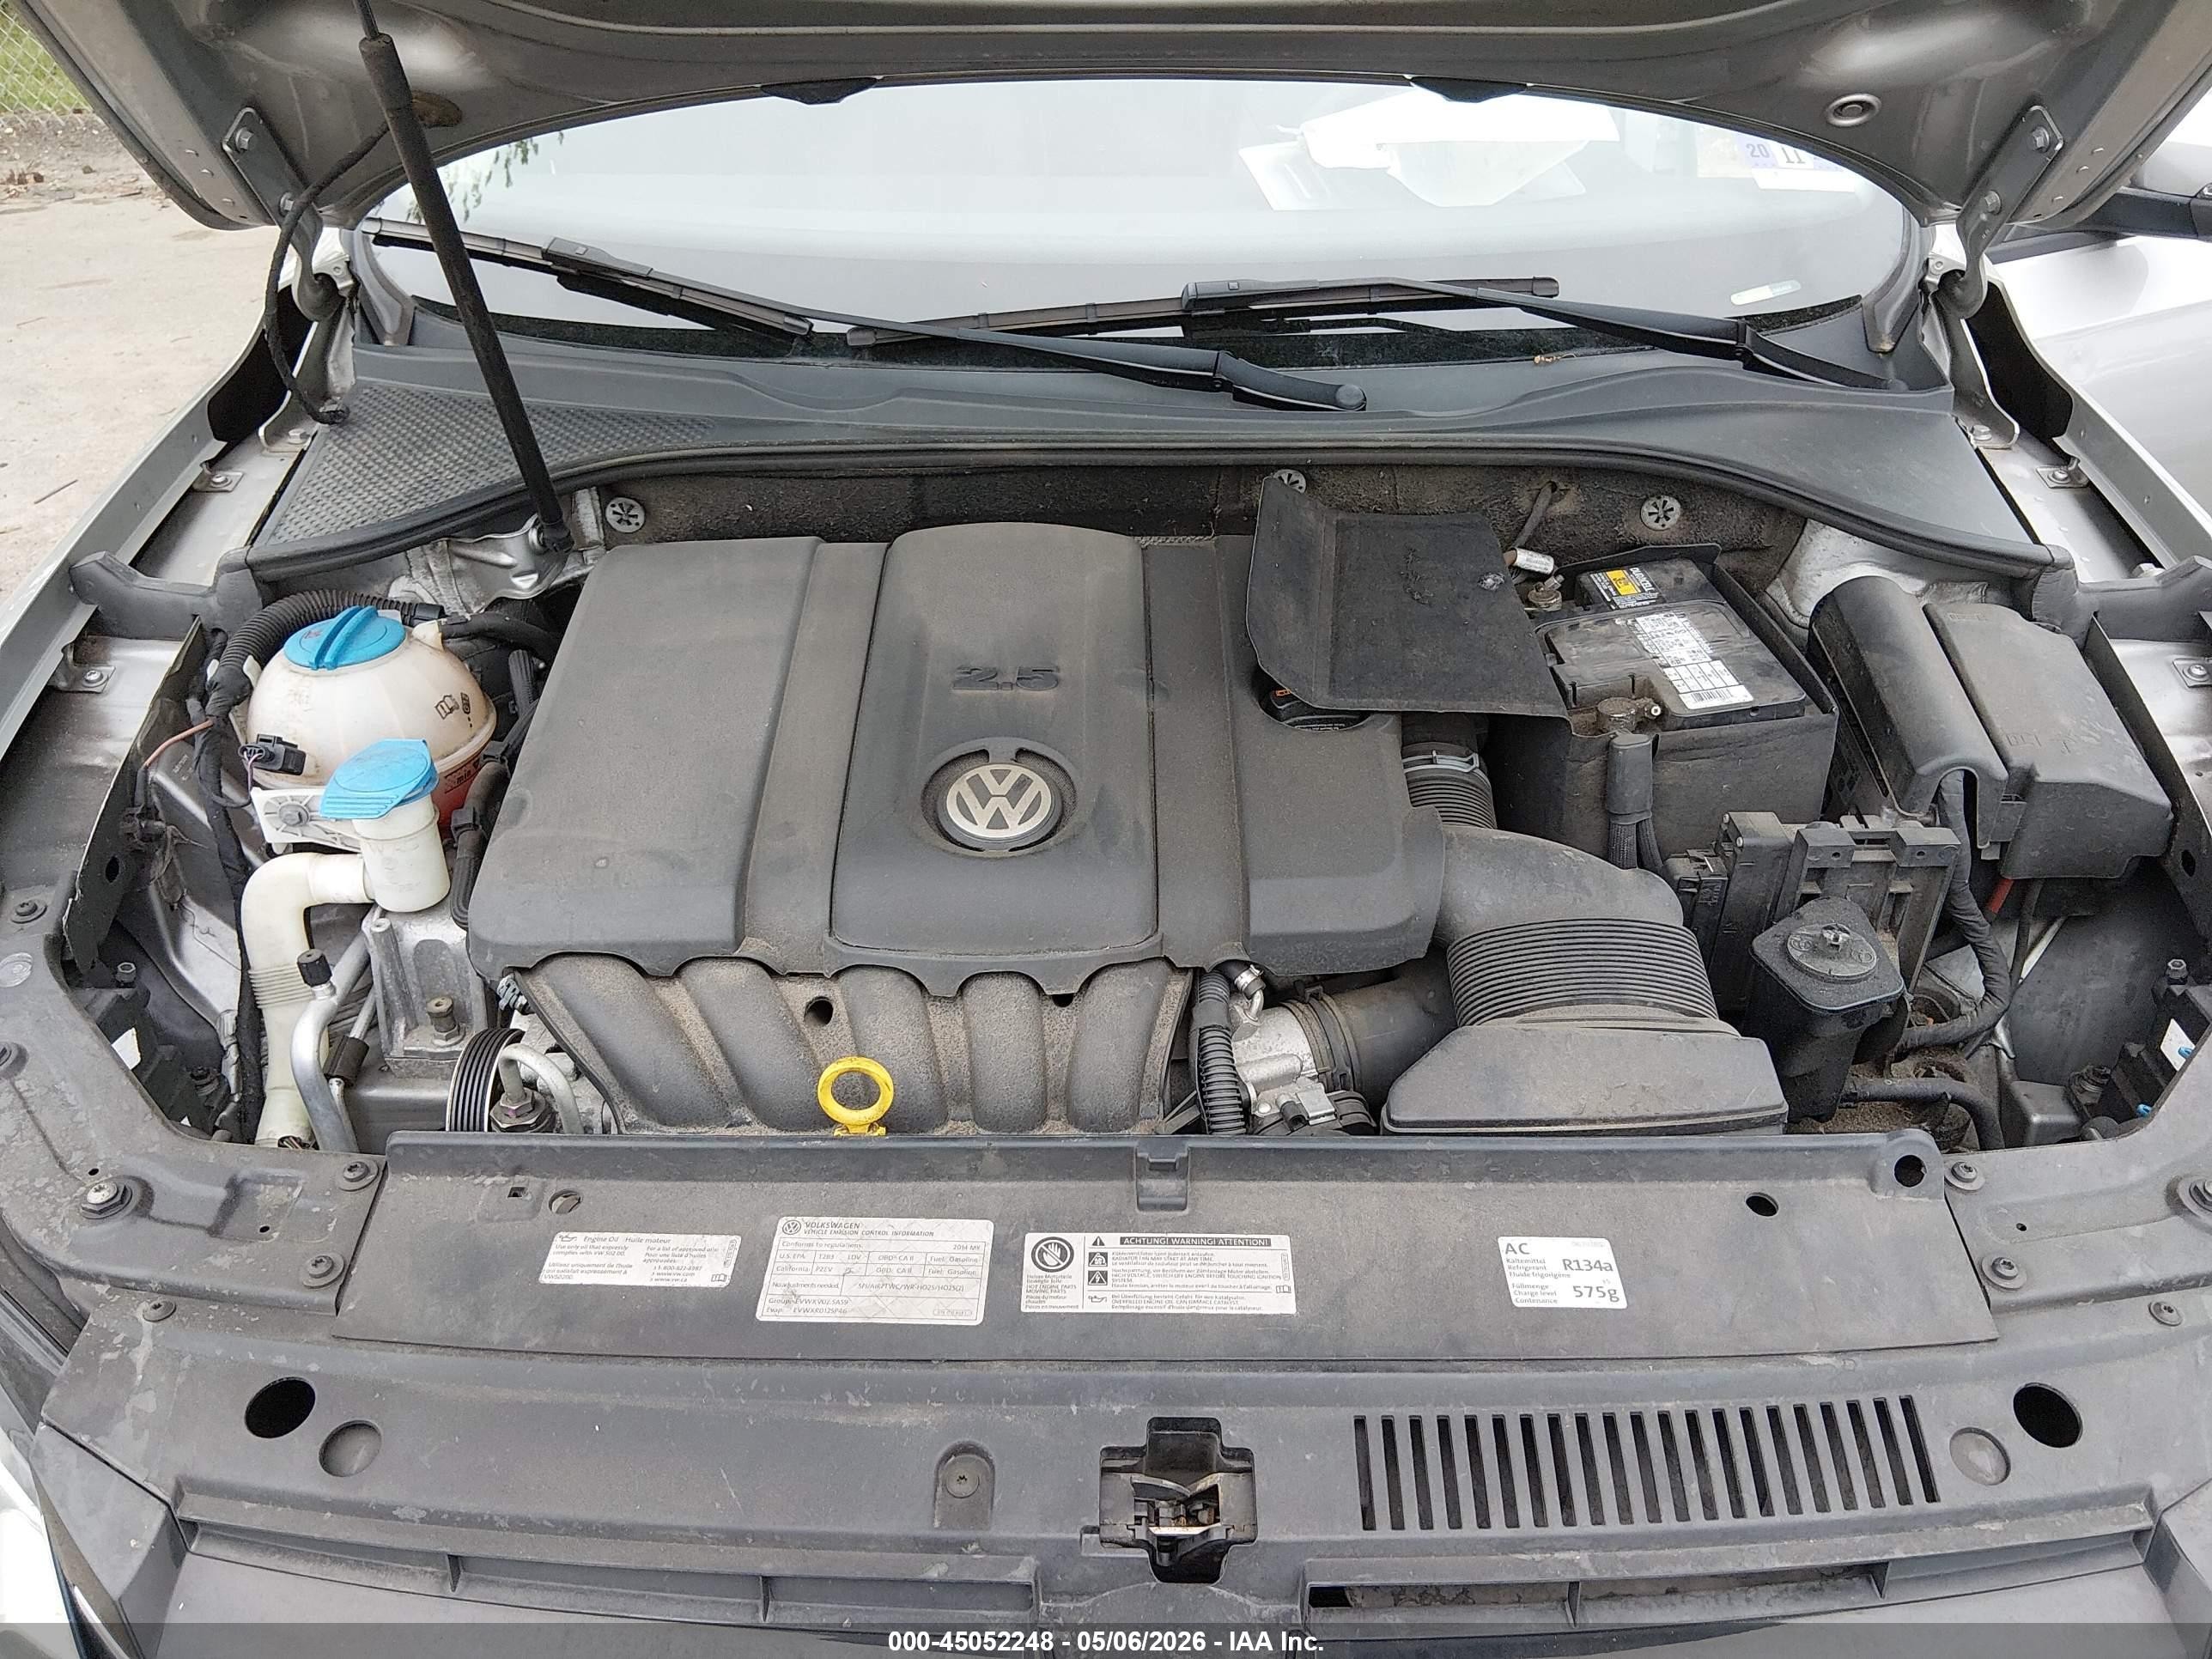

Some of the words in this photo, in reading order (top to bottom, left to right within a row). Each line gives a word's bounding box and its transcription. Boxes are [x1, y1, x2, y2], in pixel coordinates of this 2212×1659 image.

[1746, 143, 1770, 158] 20
[1629, 568, 1656, 592] DURACELL
[953, 665, 1060, 691] 2.5
[457, 769, 471, 784] min
[1505, 1243, 1530, 1255] AC
[1562, 1259, 1613, 1272] R134a
[1573, 1285, 1620, 1303] 575g
